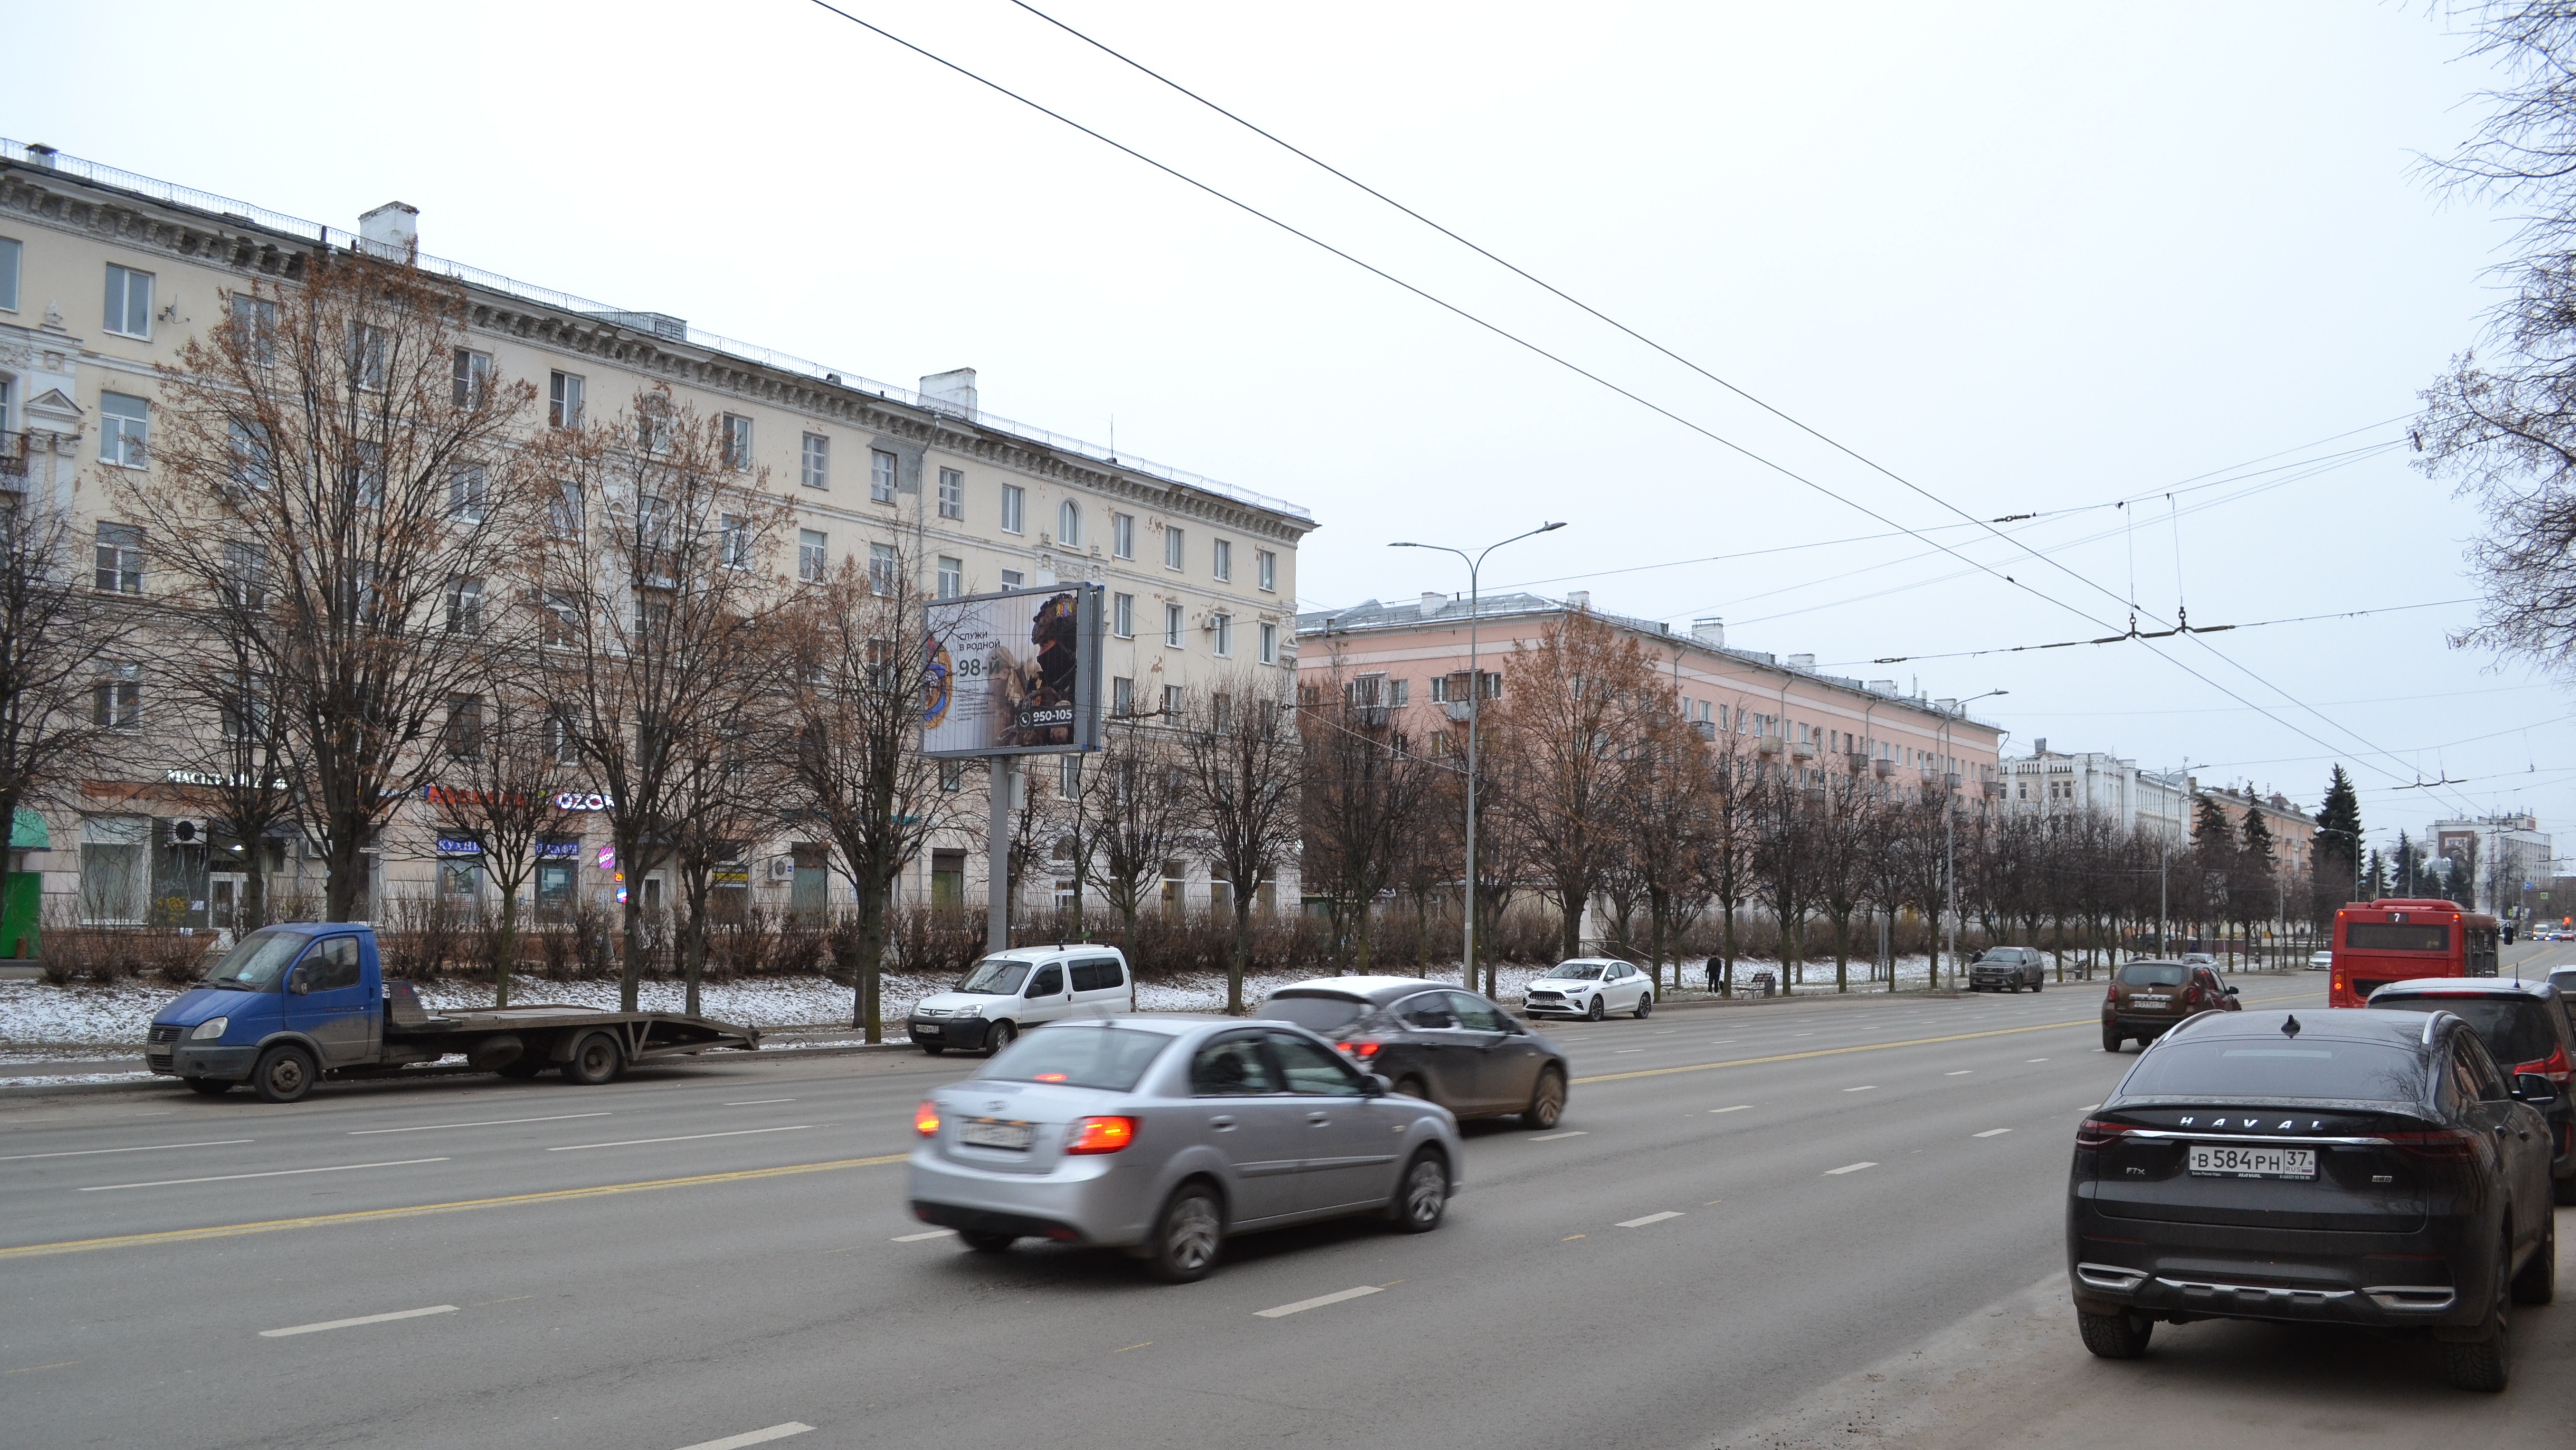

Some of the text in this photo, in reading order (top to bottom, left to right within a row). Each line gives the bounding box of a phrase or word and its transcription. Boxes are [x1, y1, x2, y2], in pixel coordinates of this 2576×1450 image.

[960, 631, 988, 640] СЛУЖИ
[967, 639, 1000, 651] РОДНОЙ
[1033, 710, 1072, 722] 950-105
[2394, 913, 2401, 923] 7
[2180, 1117, 2323, 1130] HAVAL
[2287, 1151, 2308, 1166] 37
